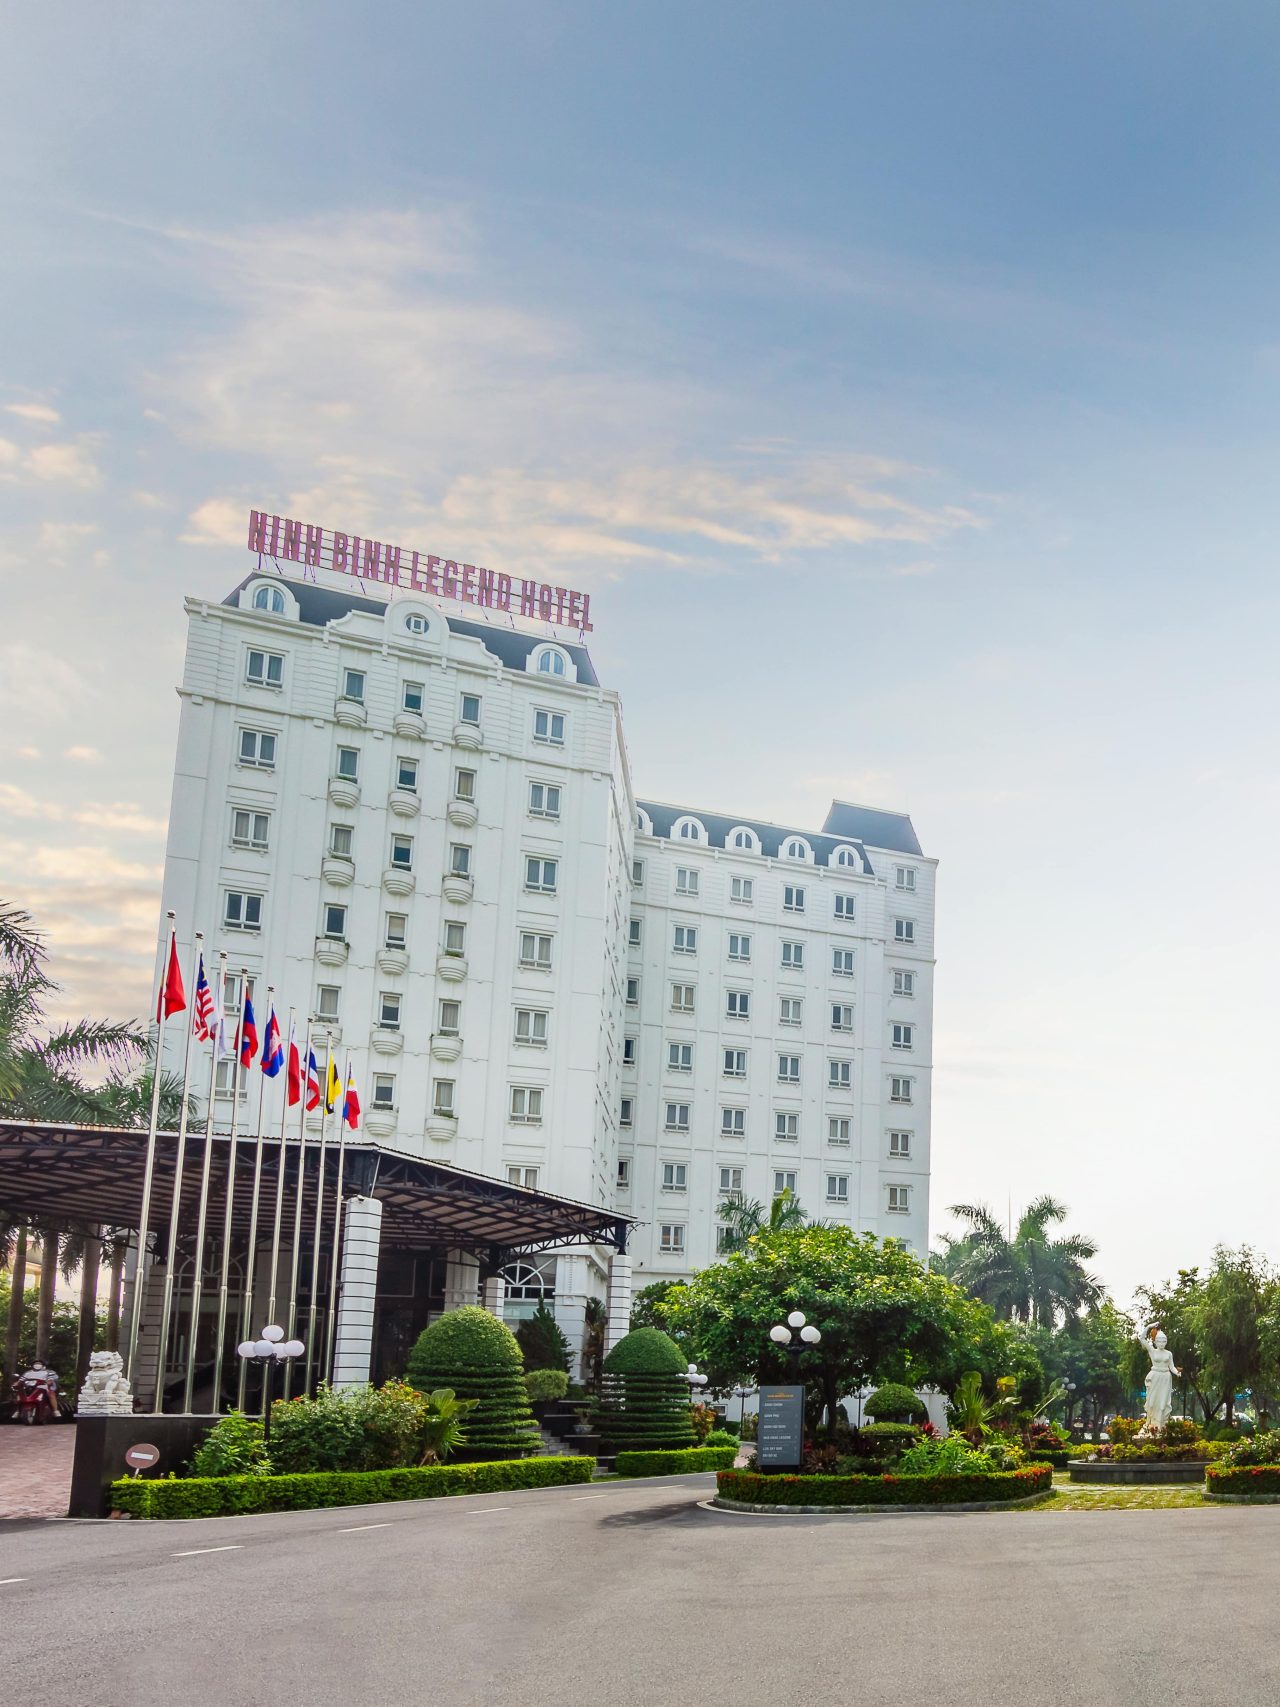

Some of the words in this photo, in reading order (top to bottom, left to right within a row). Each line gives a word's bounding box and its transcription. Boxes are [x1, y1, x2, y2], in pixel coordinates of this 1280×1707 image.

[248, 509, 322, 567] NINH
[332, 530, 401, 586] BINH
[410, 550, 512, 613] LEGEND
[520, 578, 594, 632] HOTEL
